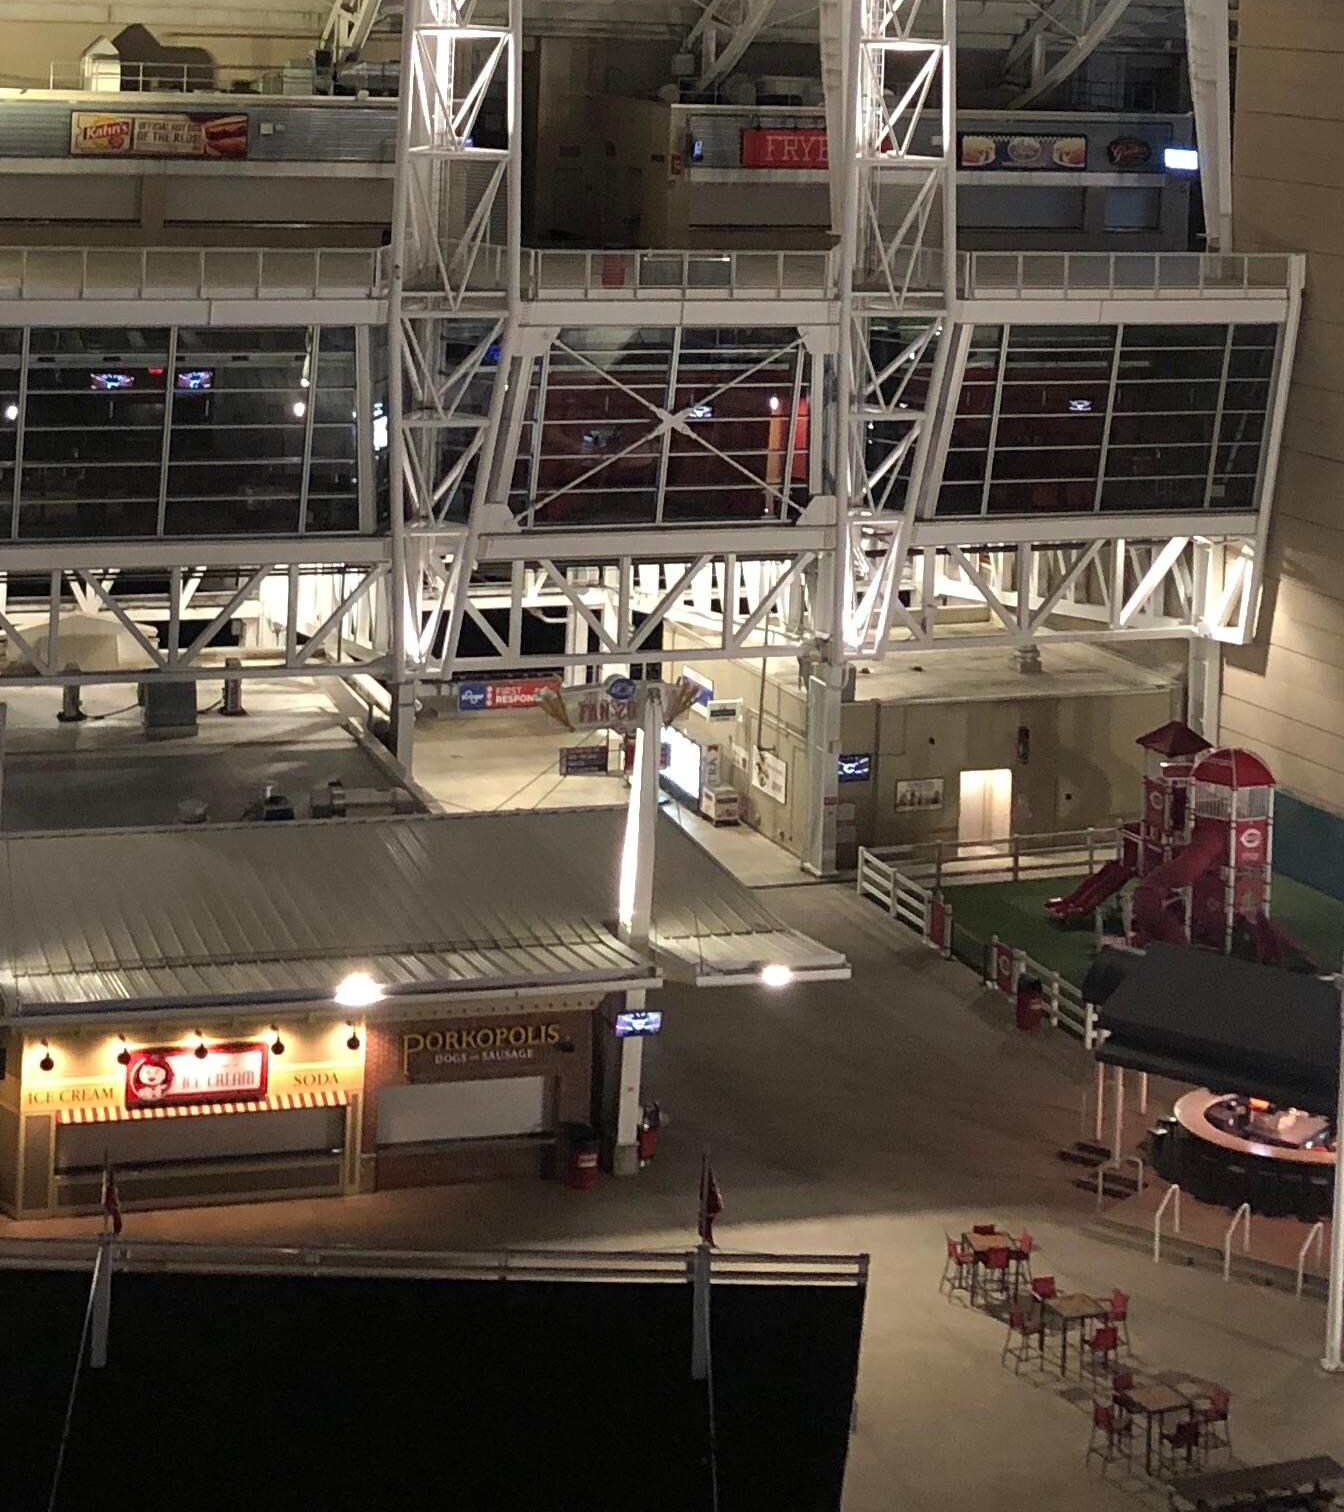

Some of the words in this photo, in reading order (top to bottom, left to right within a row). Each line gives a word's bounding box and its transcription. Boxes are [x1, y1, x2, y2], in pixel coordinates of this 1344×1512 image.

[86, 121, 129, 139] Kahn's
[403, 1024, 560, 1077] PORKOPOLIS
[435, 1052, 467, 1065] DOGS
[481, 1048, 534, 1061] SAUSAGE
[207, 1070, 255, 1088] CREAM
[293, 1071, 340, 1088] SODA
[28, 1090, 55, 1105] ICE
[59, 1087, 114, 1103] CREAM
